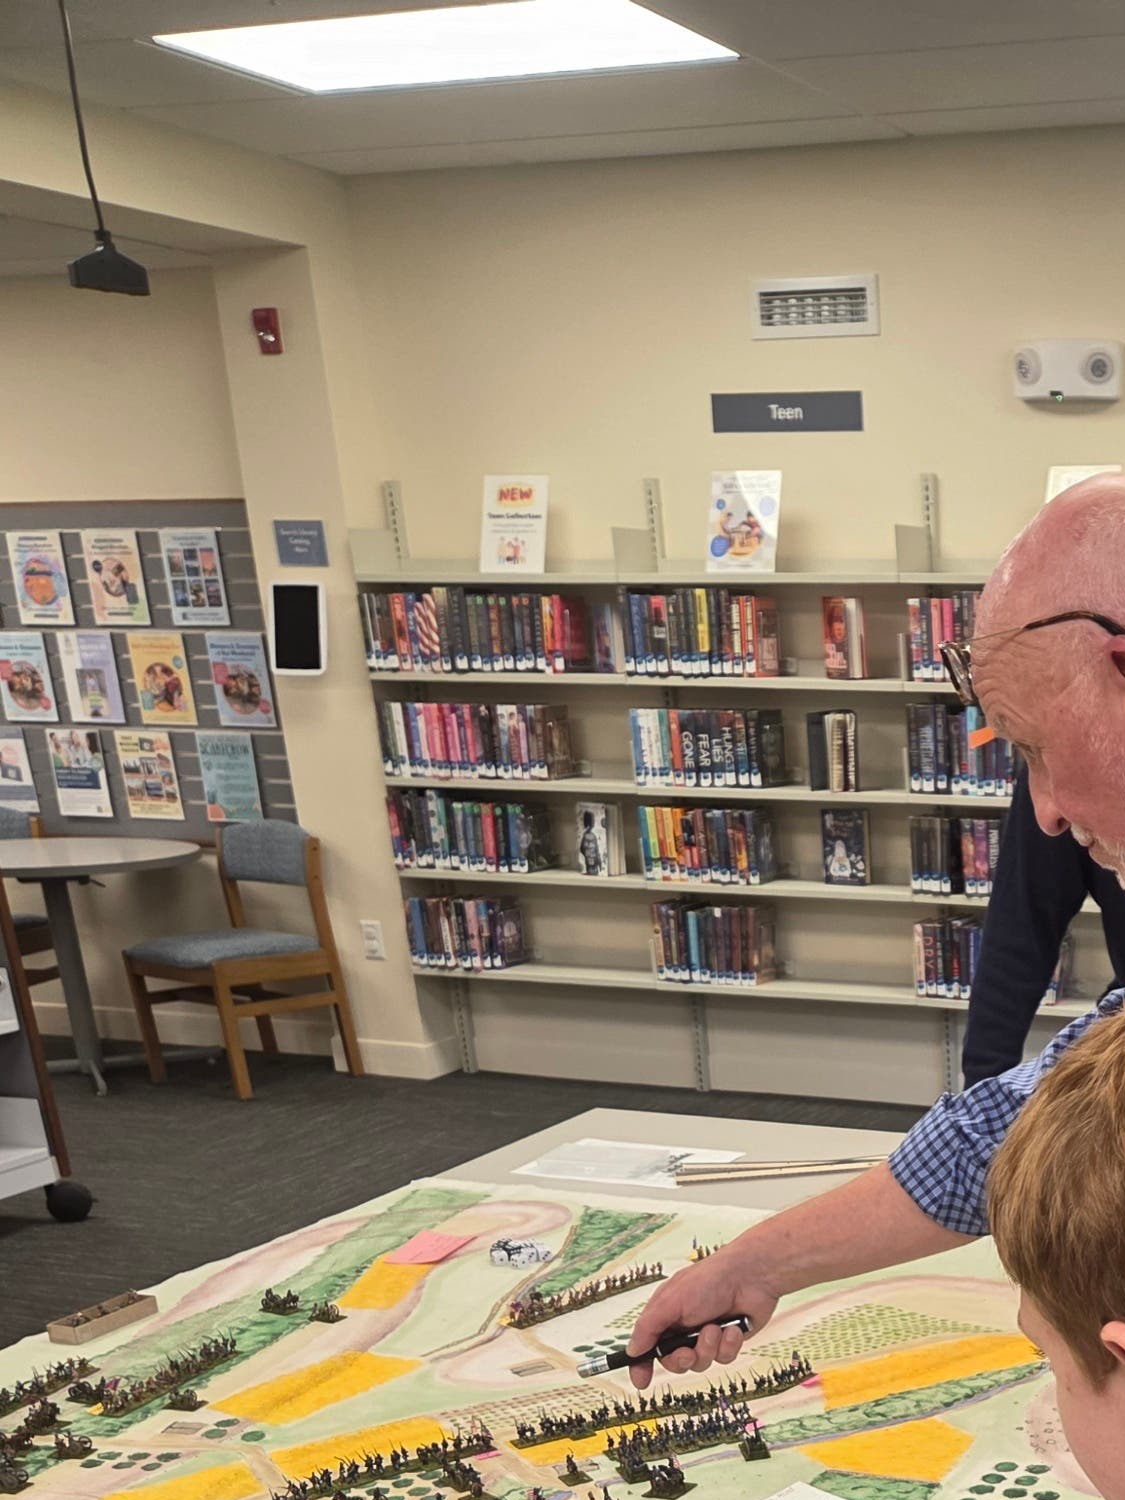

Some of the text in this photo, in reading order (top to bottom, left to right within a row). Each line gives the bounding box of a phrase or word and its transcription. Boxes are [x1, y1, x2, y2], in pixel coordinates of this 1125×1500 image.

[768, 403, 804, 420] Teen
[499, 487, 533, 501] NEW
[682, 730, 695, 769] GONE
[697, 733, 711, 767] FEAR
[711, 738, 724, 763] LIES
[923, 937, 935, 969] DRY
